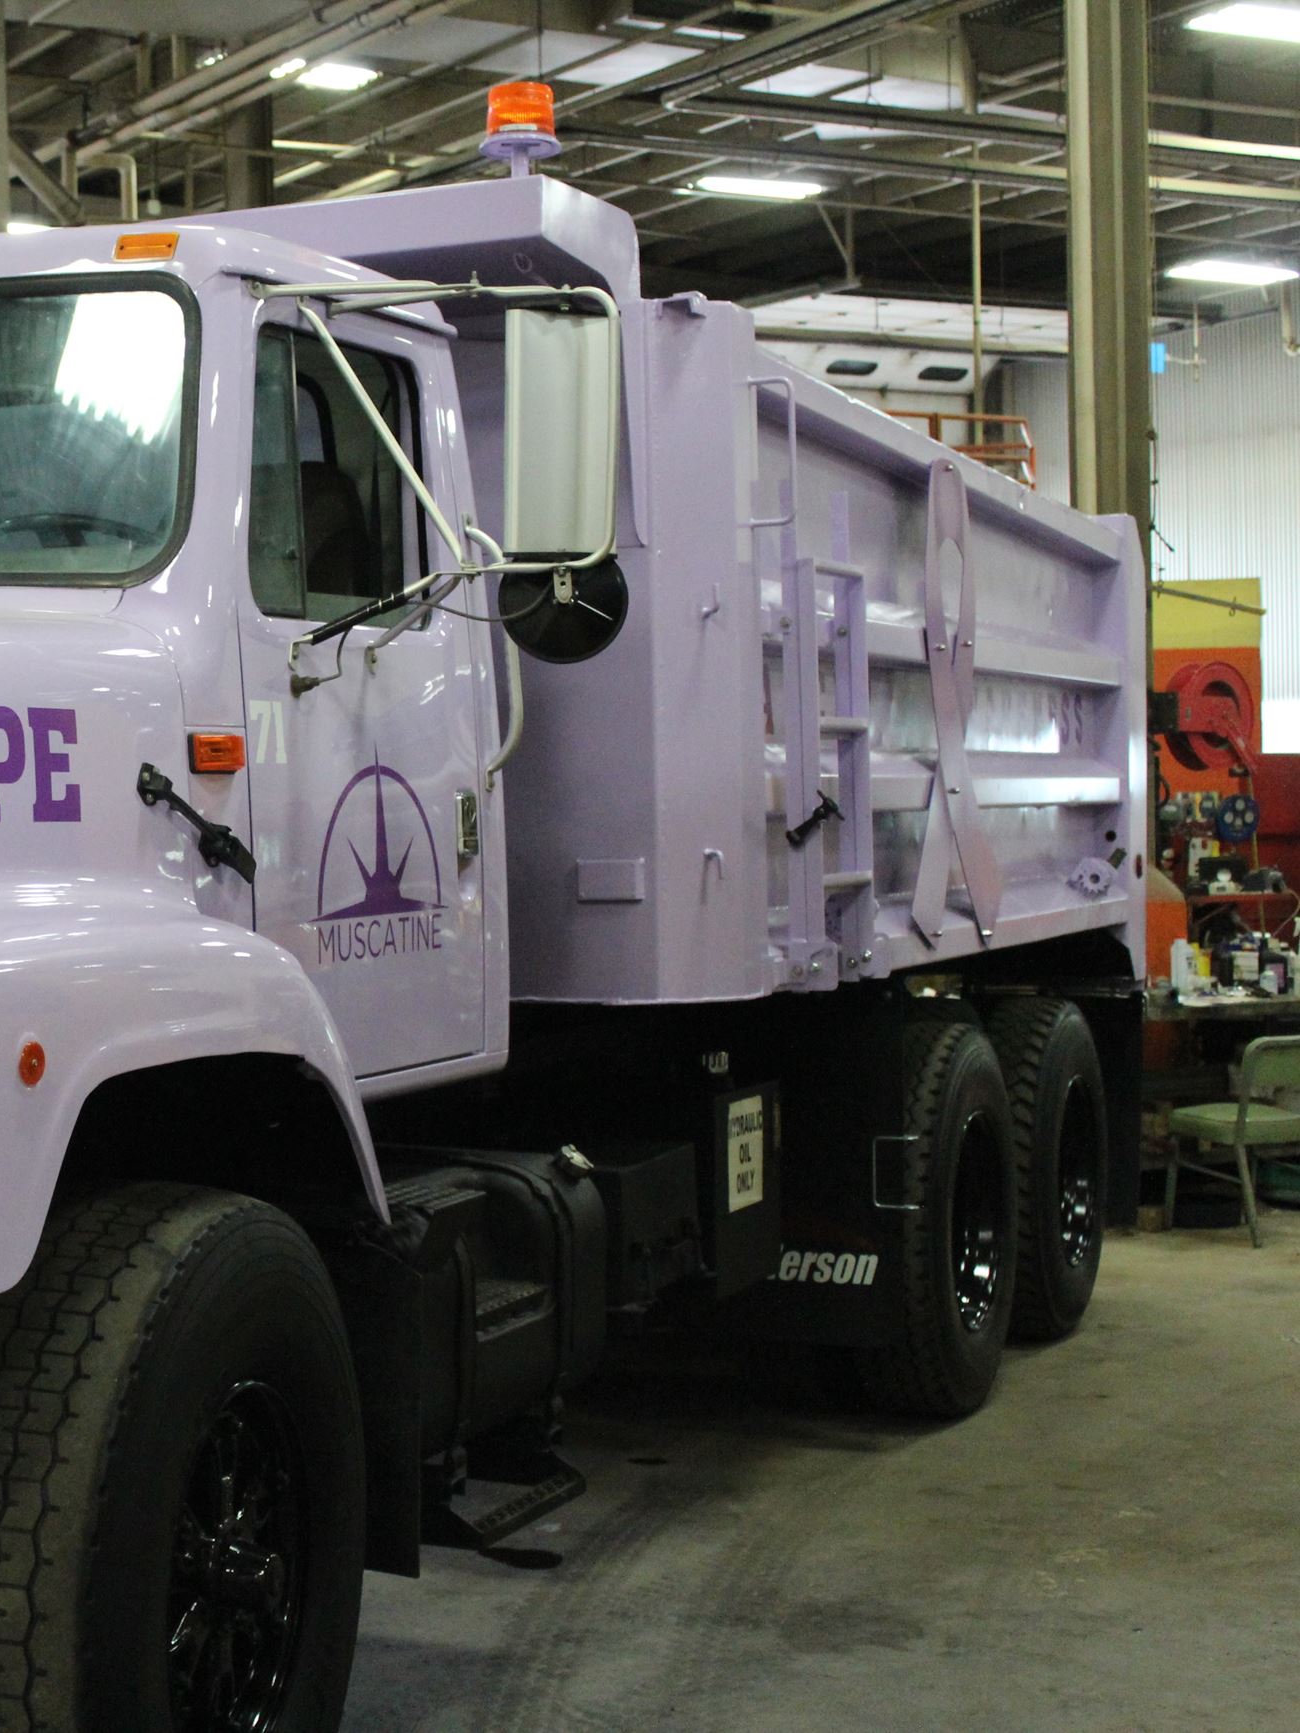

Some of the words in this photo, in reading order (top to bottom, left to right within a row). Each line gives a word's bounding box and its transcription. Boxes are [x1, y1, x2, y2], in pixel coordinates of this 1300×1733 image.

[250, 700, 288, 764] 71
[317, 914, 442, 964] MUSCATINE
[739, 1142, 752, 1165] OIL
[736, 1168, 756, 1195] ONLY
[767, 1243, 879, 1286] erson
